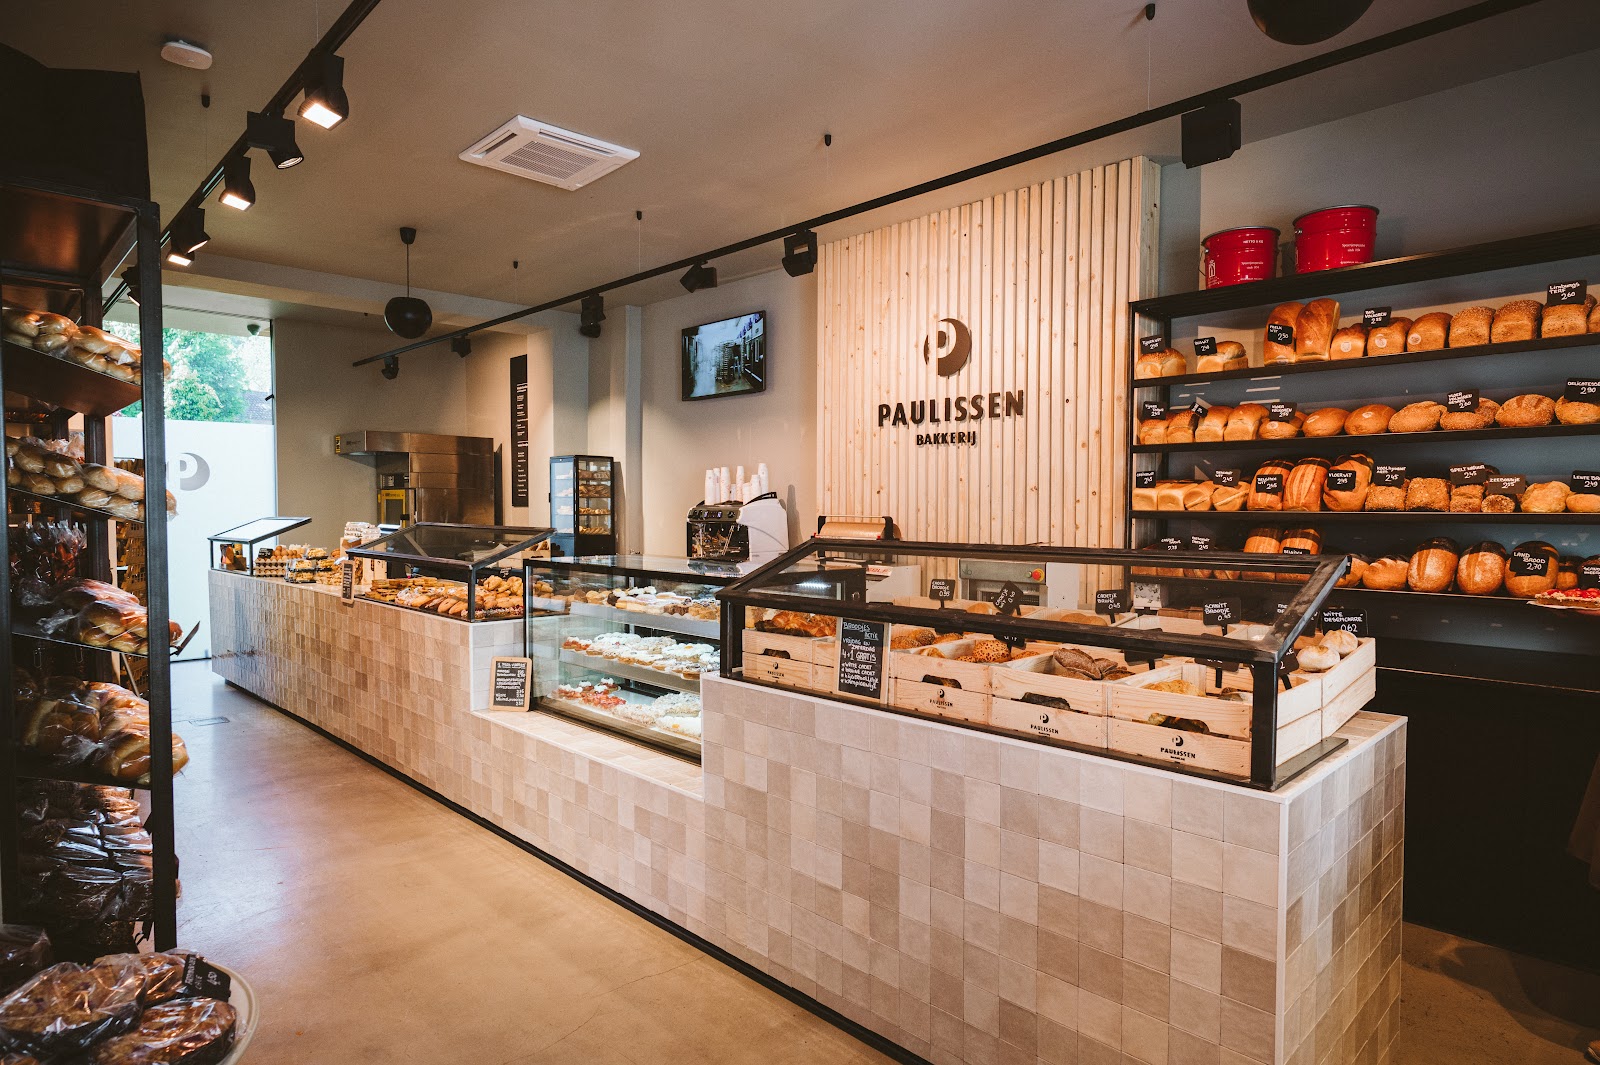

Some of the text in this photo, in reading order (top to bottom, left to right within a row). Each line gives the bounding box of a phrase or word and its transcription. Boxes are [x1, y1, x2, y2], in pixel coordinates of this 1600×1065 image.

[878, 390, 1024, 427] PAULISSEN
[916, 431, 976, 446] BAKKERIJ
[856, 652, 876, 661] GRATIS
